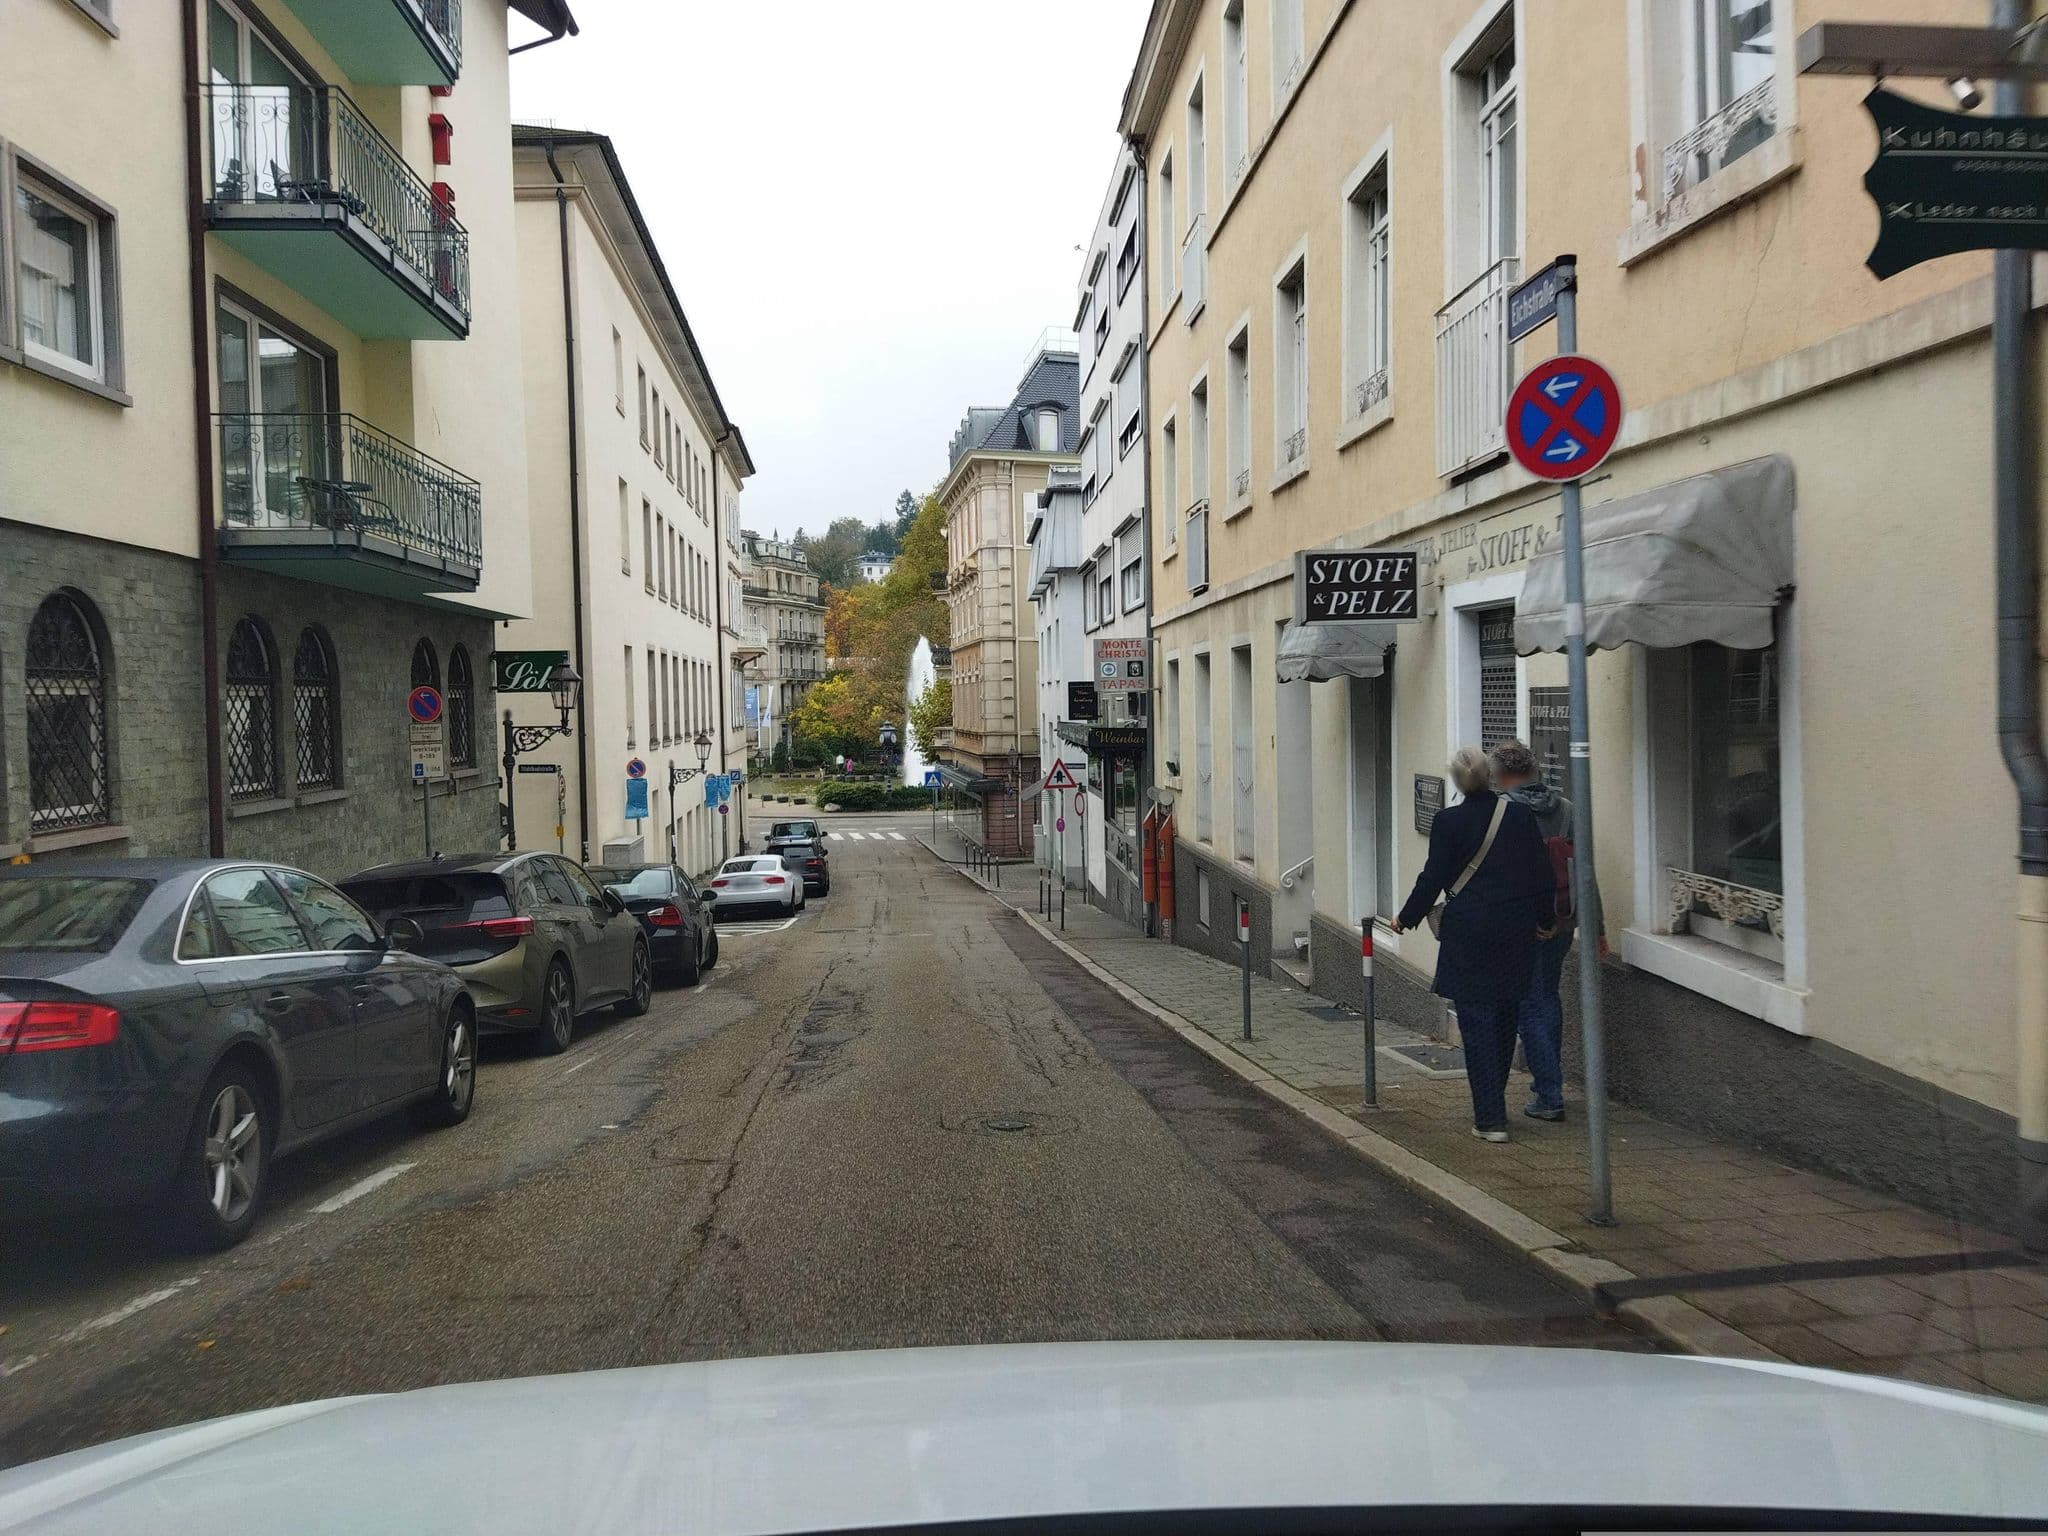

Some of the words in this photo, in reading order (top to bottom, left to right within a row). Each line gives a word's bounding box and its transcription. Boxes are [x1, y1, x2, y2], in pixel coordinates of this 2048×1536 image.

[1479, 523, 1533, 571] STOFF
[1308, 557, 1414, 585] STOFF
[1313, 592, 1328, 605] &
[1325, 589, 1414, 616] PELZ
[1101, 640, 1142, 650] MONTE
[1097, 649, 1147, 659] CHRISTO
[1100, 680, 1146, 690] TAPAS
[1095, 730, 1145, 744] Weinbar
